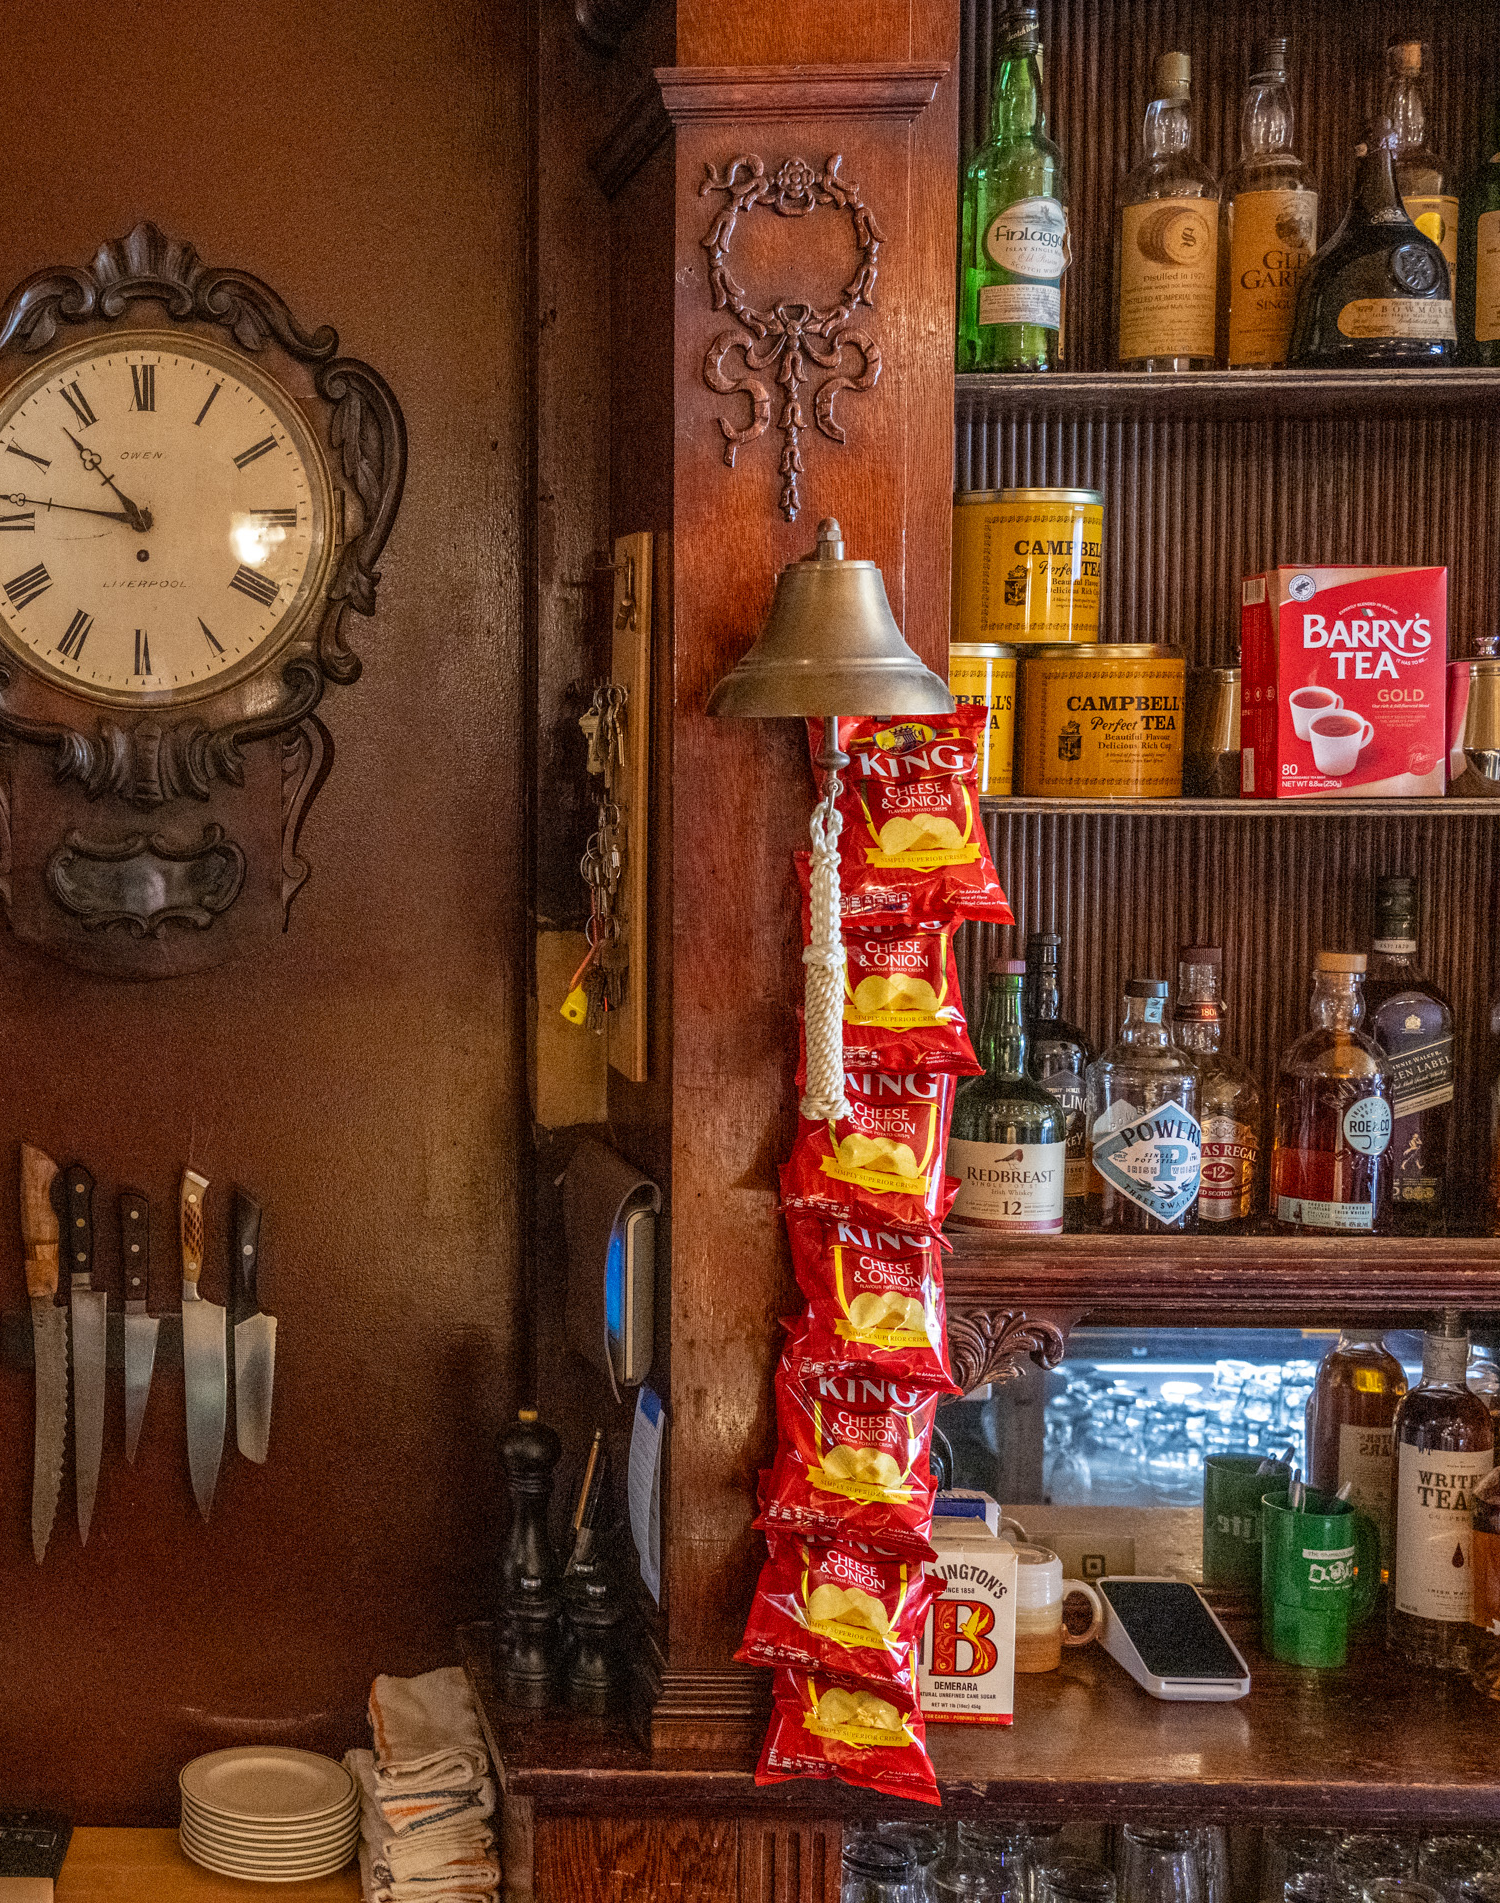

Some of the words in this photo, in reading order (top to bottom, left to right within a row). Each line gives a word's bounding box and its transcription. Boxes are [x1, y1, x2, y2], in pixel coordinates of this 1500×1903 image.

[1143, 272, 1178, 282] Distilled
[1256, 300, 1292, 311] SINGL
[120, 451, 164, 461] OWEN
[1303, 613, 1432, 655] BARRY'S
[1330, 651, 1400, 680] TEA
[1066, 696, 1185, 712] CAMPBELL'
[1377, 689, 1424, 703] GOLD
[1090, 716, 1139, 733] Perfect
[1141, 715, 1176, 730] TEA
[1098, 741, 1137, 750] Delicious
[1141, 741, 1159, 750] Rich
[1160, 742, 1172, 751] Cup
[1105, 733, 1143, 741] Beautiful
[1146, 733, 1170, 741] Flavour
[857, 745, 965, 778] KING
[1282, 764, 1298, 776] 80
[885, 782, 944, 799] CHEESE
[881, 797, 895, 810] &
[895, 793, 953, 808] ONION
[907, 855, 943, 863] SUPERIOR
[865, 941, 922, 954] CHEESE
[859, 955, 873, 967] &
[874, 953, 929, 967] ONION
[1417, 1055, 1453, 1075] LABEL
[854, 1102, 910, 1121] CHEESE
[847, 1112, 859, 1125] &
[861, 1116, 916, 1135] ONION
[1120, 1120, 1201, 1148] POWERS
[1223, 1145, 1257, 1163] REGAL
[1127, 1165, 1158, 1175] IRISH
[1153, 1145, 1189, 1182] P
[1212, 1166, 1226, 1179] 12
[834, 1168, 859, 1179] SIMPLY
[859, 1174, 895, 1187] SUPERIOR
[895, 1181, 919, 1190] CRISPS
[967, 1166, 1054, 1184] REDBREAST
[1008, 1189, 1034, 1197] Whiskey
[1124, 1183, 1156, 1207] THREE
[1002, 1201, 1022, 1216] 12
[859, 1256, 914, 1275] CHEESE
[853, 1270, 867, 1283] &
[868, 1270, 922, 1287] ONION
[838, 1411, 894, 1429] CHEESE
[831, 1423, 845, 1435] &
[845, 1426, 898, 1445] ONION
[1419, 1470, 1478, 1489] WRITE
[1418, 1486, 1468, 1511] TEA
[826, 1550, 879, 1578] CHEESE
[820, 1561, 833, 1575] &
[833, 1564, 886, 1591] ONION
[824, 1575, 847, 1584] FLAVOUR
[809, 1620, 829, 1632] IMPLY
[830, 1627, 865, 1641] SUPERIOR
[929, 1599, 999, 1677] B
[934, 1681, 978, 1692] DEMERARA
[816, 1725, 841, 1735] SIMPLY
[842, 1730, 879, 1741] SUPERIOR
[879, 1734, 903, 1742] CRISPS
